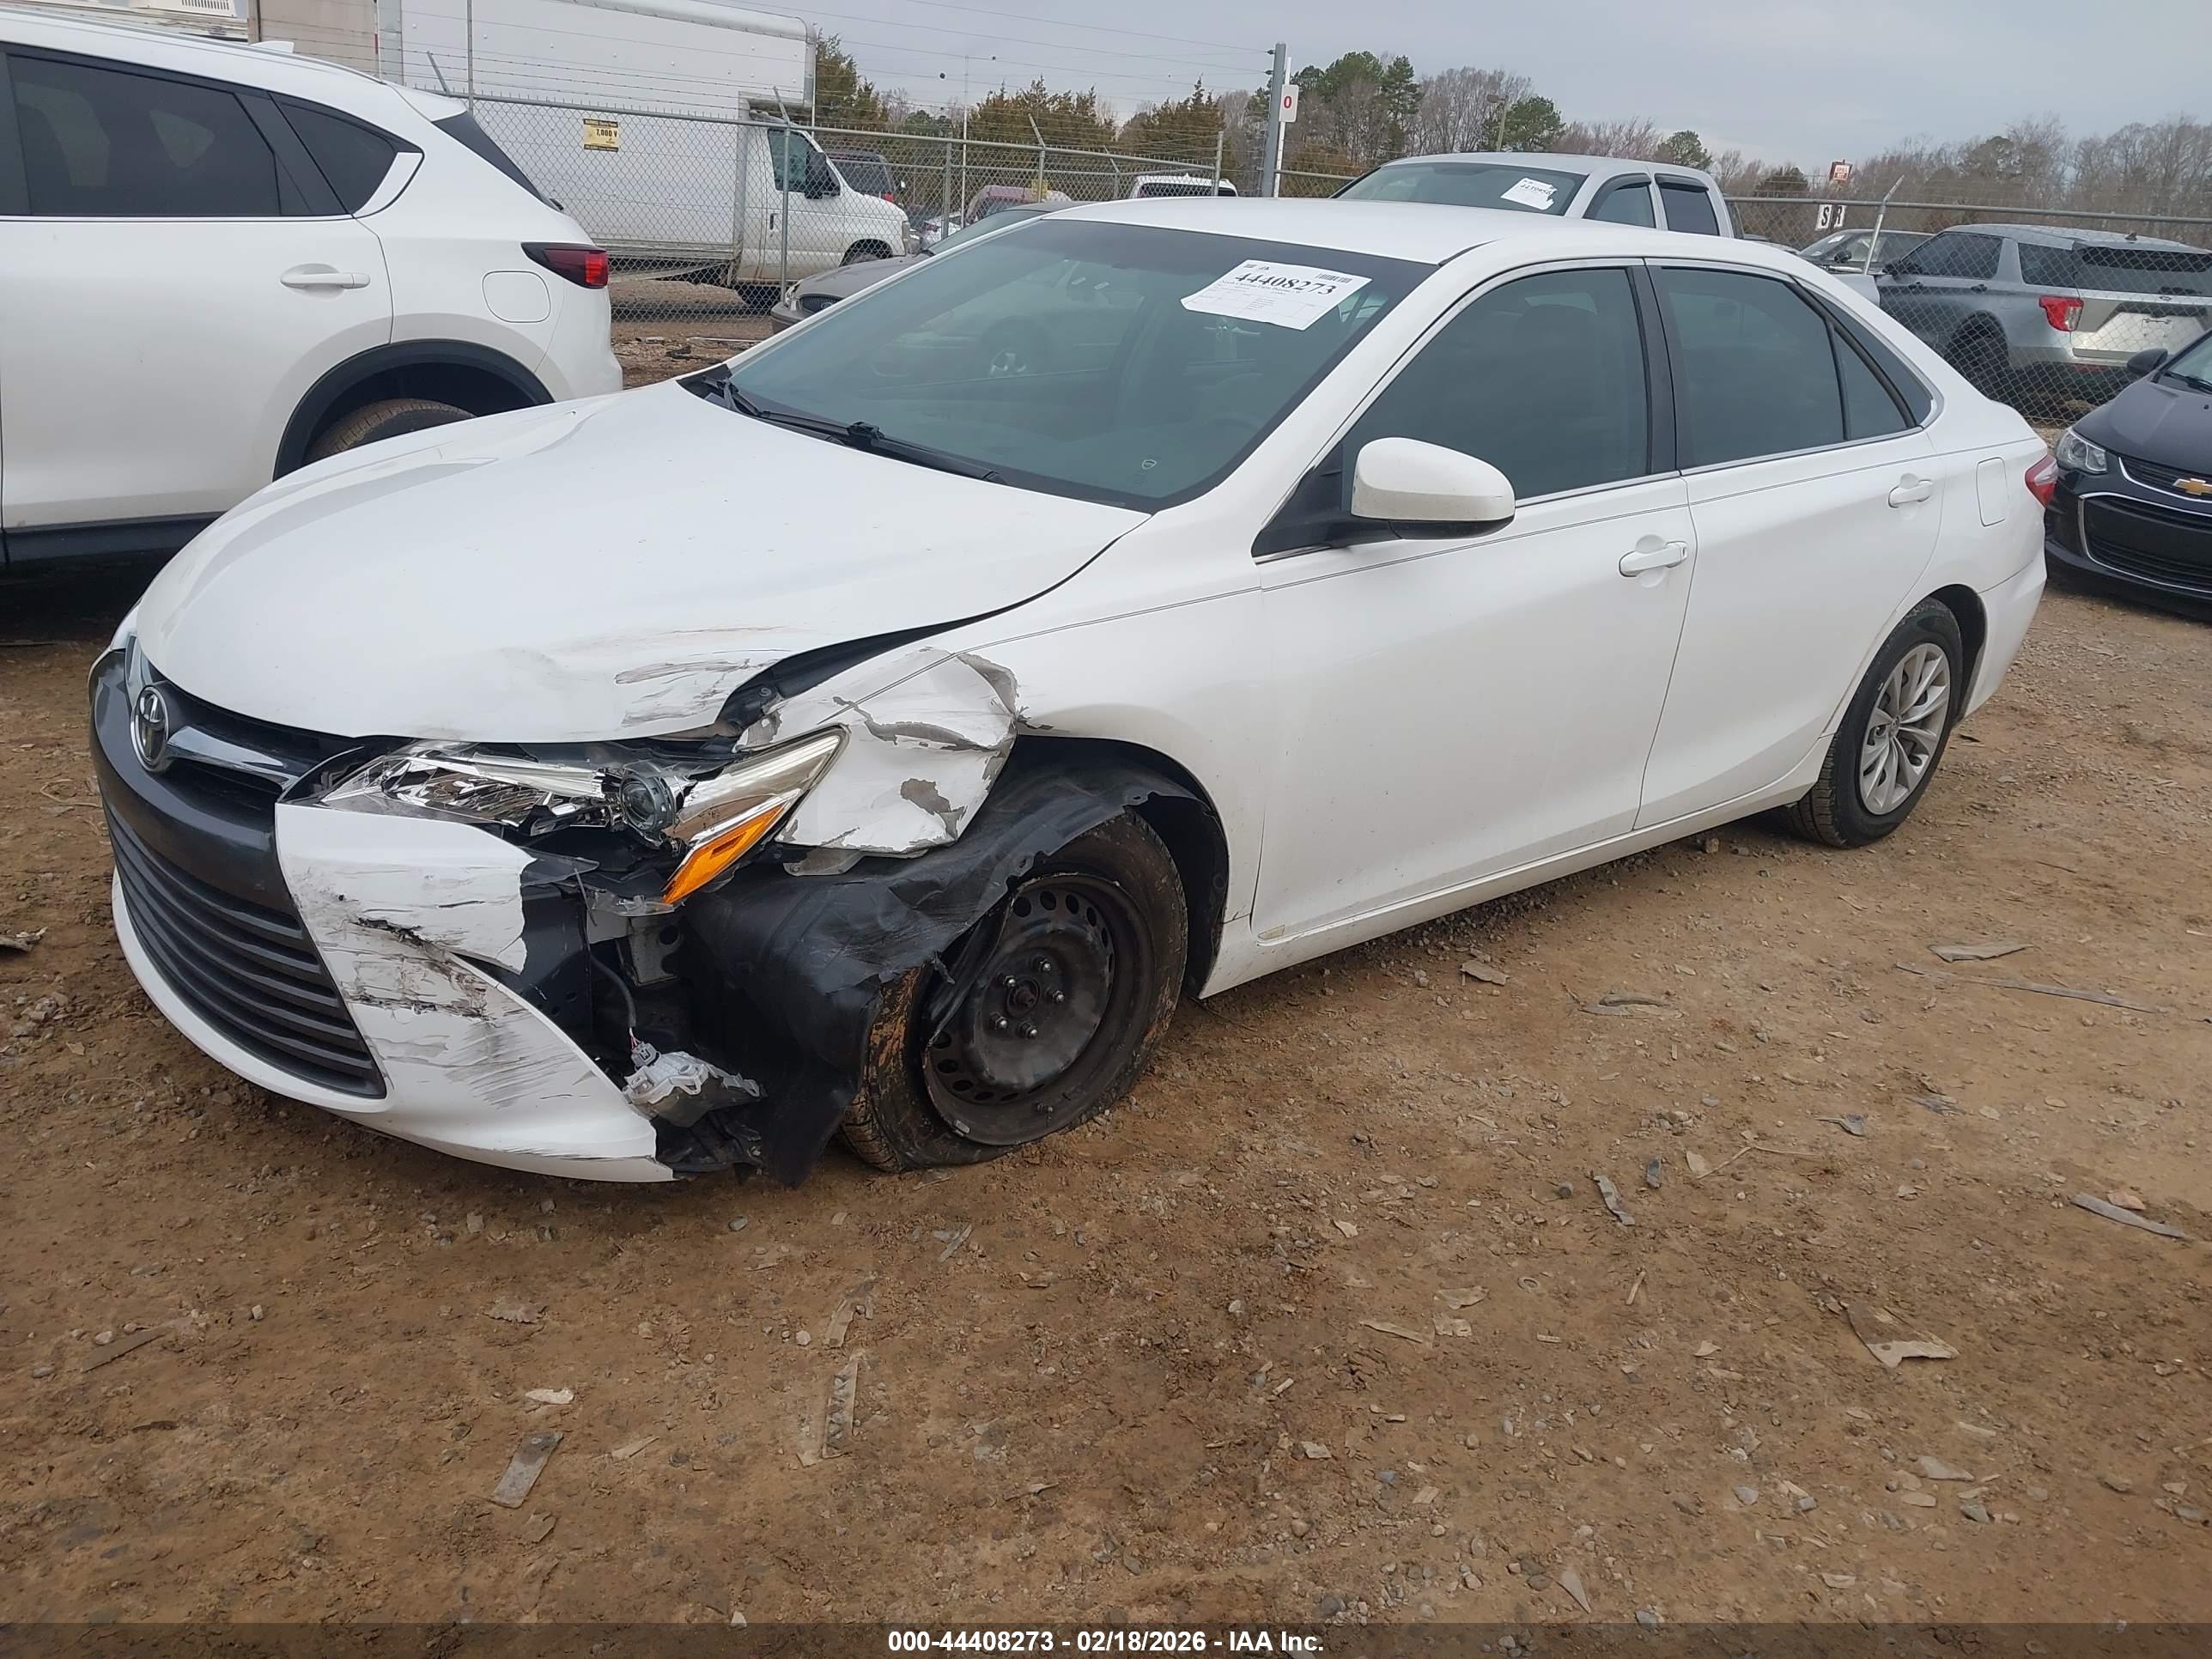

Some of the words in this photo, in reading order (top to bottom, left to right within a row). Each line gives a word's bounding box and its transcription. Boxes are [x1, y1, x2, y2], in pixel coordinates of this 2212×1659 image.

[1283, 95, 1292, 109] 0
[1821, 206, 1830, 227] S
[1235, 273, 1337, 295] 44408273
